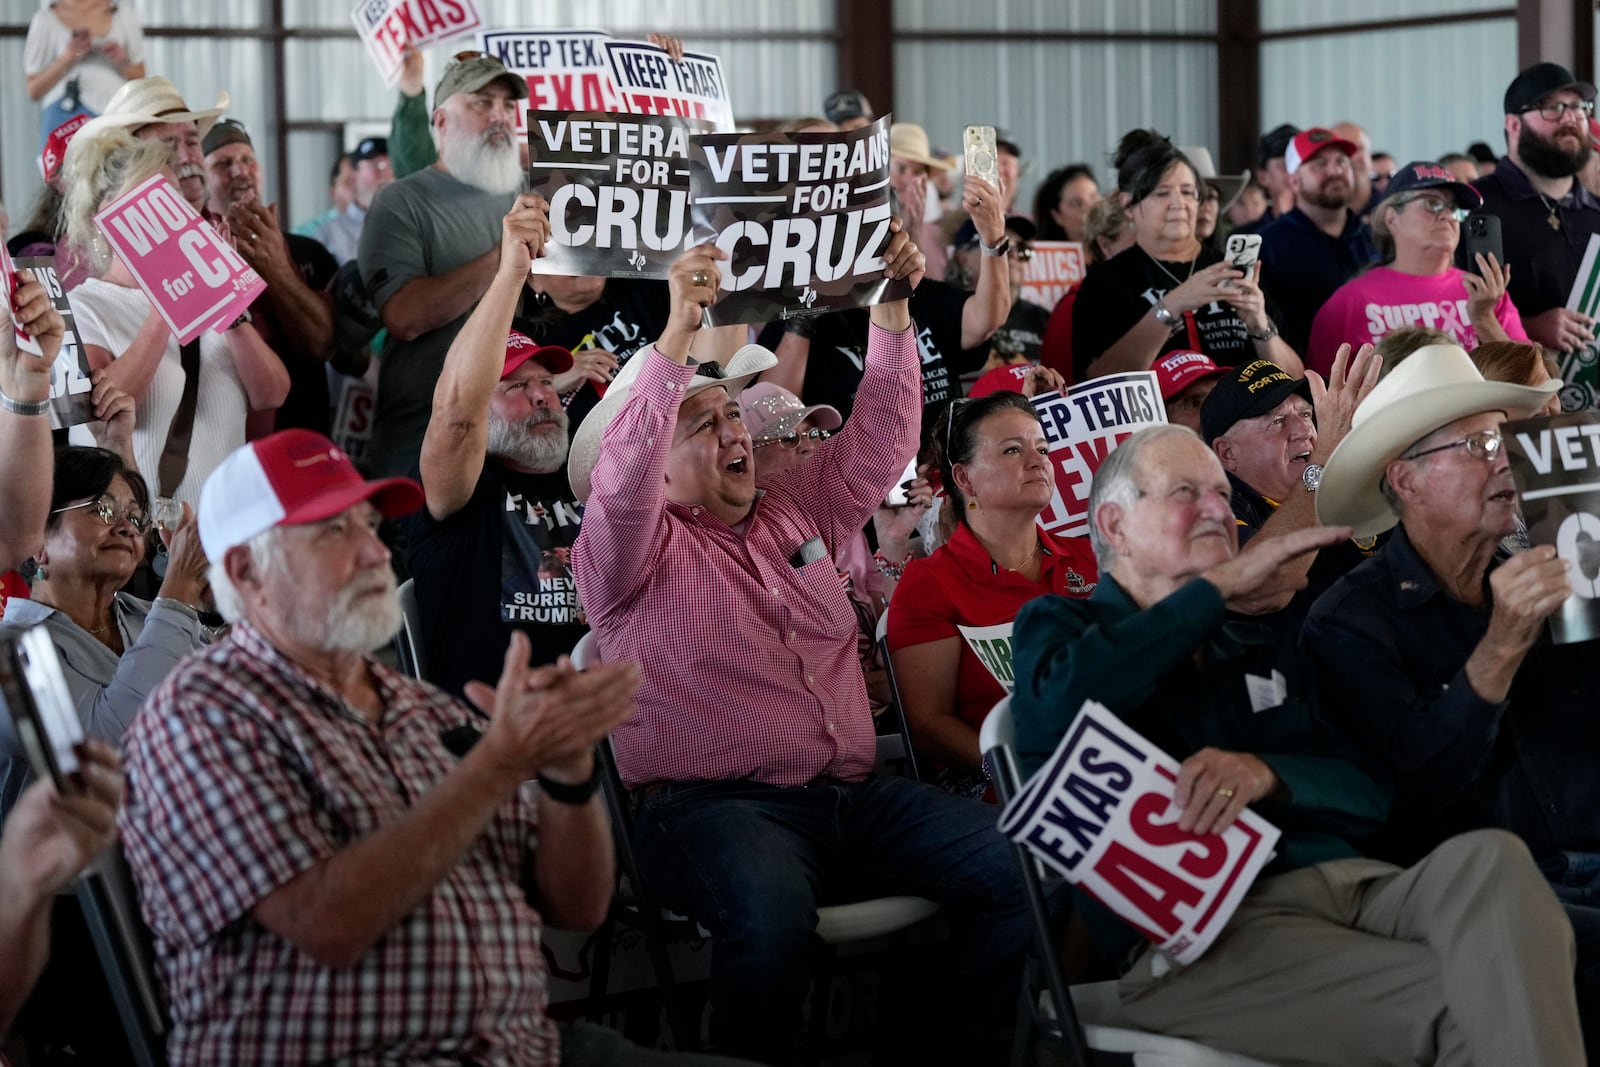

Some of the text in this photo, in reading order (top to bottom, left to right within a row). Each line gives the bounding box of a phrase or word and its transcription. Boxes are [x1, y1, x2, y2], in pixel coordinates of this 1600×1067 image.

[375, 0, 466, 54] TEXAS
[497, 40, 604, 68] KEEP TEX
[620, 53, 720, 99] KEEP TEXAS
[538, 120, 700, 158] VETERA
[703, 128, 889, 183] VETERANS
[615, 158, 669, 185] FOR
[549, 183, 693, 252] CRU
[792, 182, 850, 214] FOR
[715, 203, 891, 292] CRUZ
[162, 270, 195, 302] for
[1248, 377, 1272, 394] FOR
[1073, 385, 1154, 432] TEXAS
[505, 604, 577, 623] TRUMP
[969, 636, 1014, 681] FAR
[1026, 746, 1133, 872] EXAS
[1093, 792, 1229, 937] AS
